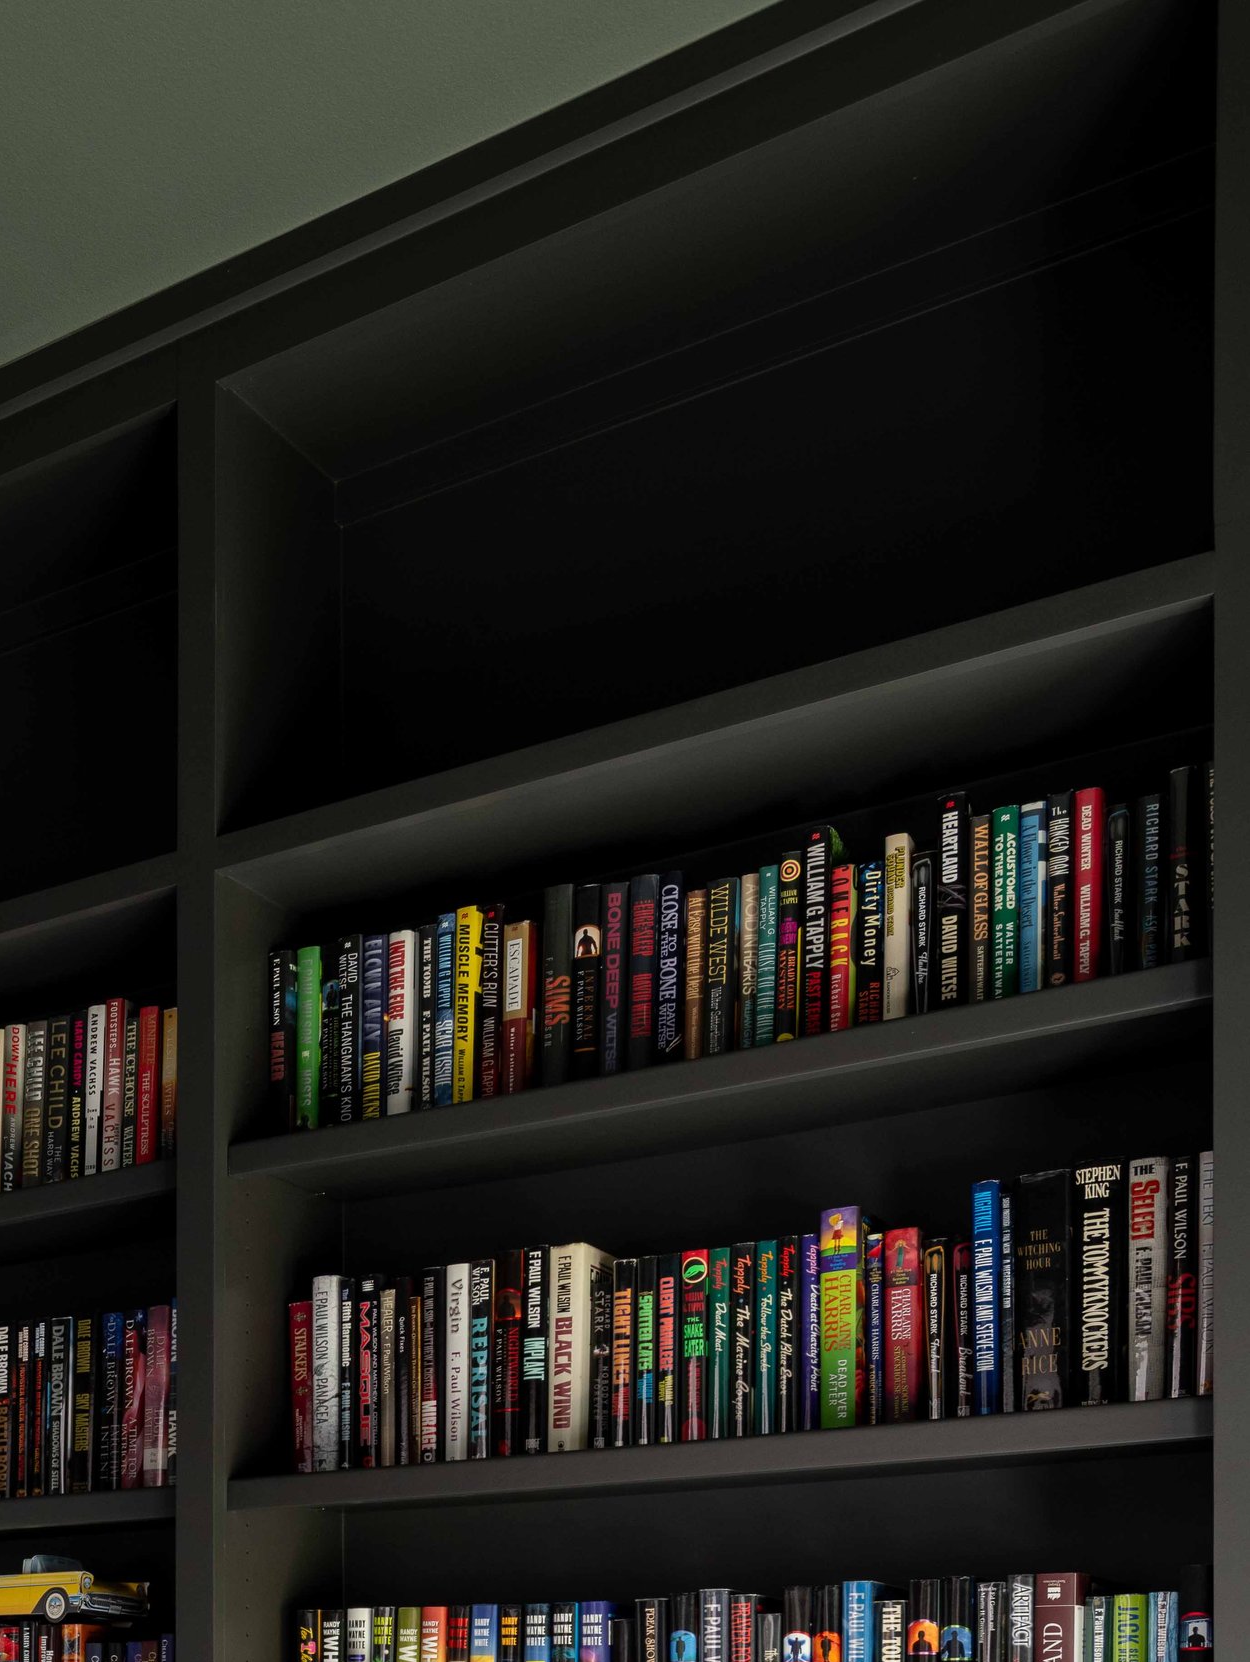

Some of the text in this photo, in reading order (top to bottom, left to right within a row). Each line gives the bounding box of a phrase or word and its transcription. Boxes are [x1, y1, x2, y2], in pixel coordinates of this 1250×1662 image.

[942, 812, 958, 883] HEARTLAND
[974, 824, 988, 941] WALL OF GLASS
[864, 870, 881, 966] Dirty Money
[458, 924, 470, 1042] MUSCLE MEMORY
[482, 922, 499, 1008] CUTTER'S RUN
[508, 942, 520, 1008] ESCAPADE
[606, 892, 622, 1071] BONE DEEP WILTSE
[6, 1063, 16, 1115] HERE
[140, 1070, 150, 1156] THE SCULPTRESS
[1076, 1165, 1120, 1184] STEPHEN
[1085, 1183, 1109, 1199] KING
[1133, 1165, 1155, 1175] THE
[1031, 1230, 1048, 1240] THE
[1131, 1180, 1159, 1240] SELECT
[1017, 1243, 1061, 1256] WITCHING
[1027, 1258, 1051, 1270] HOUR
[451, 1278, 462, 1333] Virgin
[825, 1277, 838, 1352] HARRIS
[840, 1274, 851, 1348] CHARLAINE
[1018, 1328, 1061, 1348] ANNE
[1022, 1355, 1057, 1375] RICE
[472, 1316, 488, 1443] REPRISAL
[553, 1318, 572, 1429] BLACK WIND
[837, 1359, 848, 1419] DEAD EVER
[882, 1605, 900, 1636] THE
[1012, 1583, 1032, 1646] ARTIFACT
